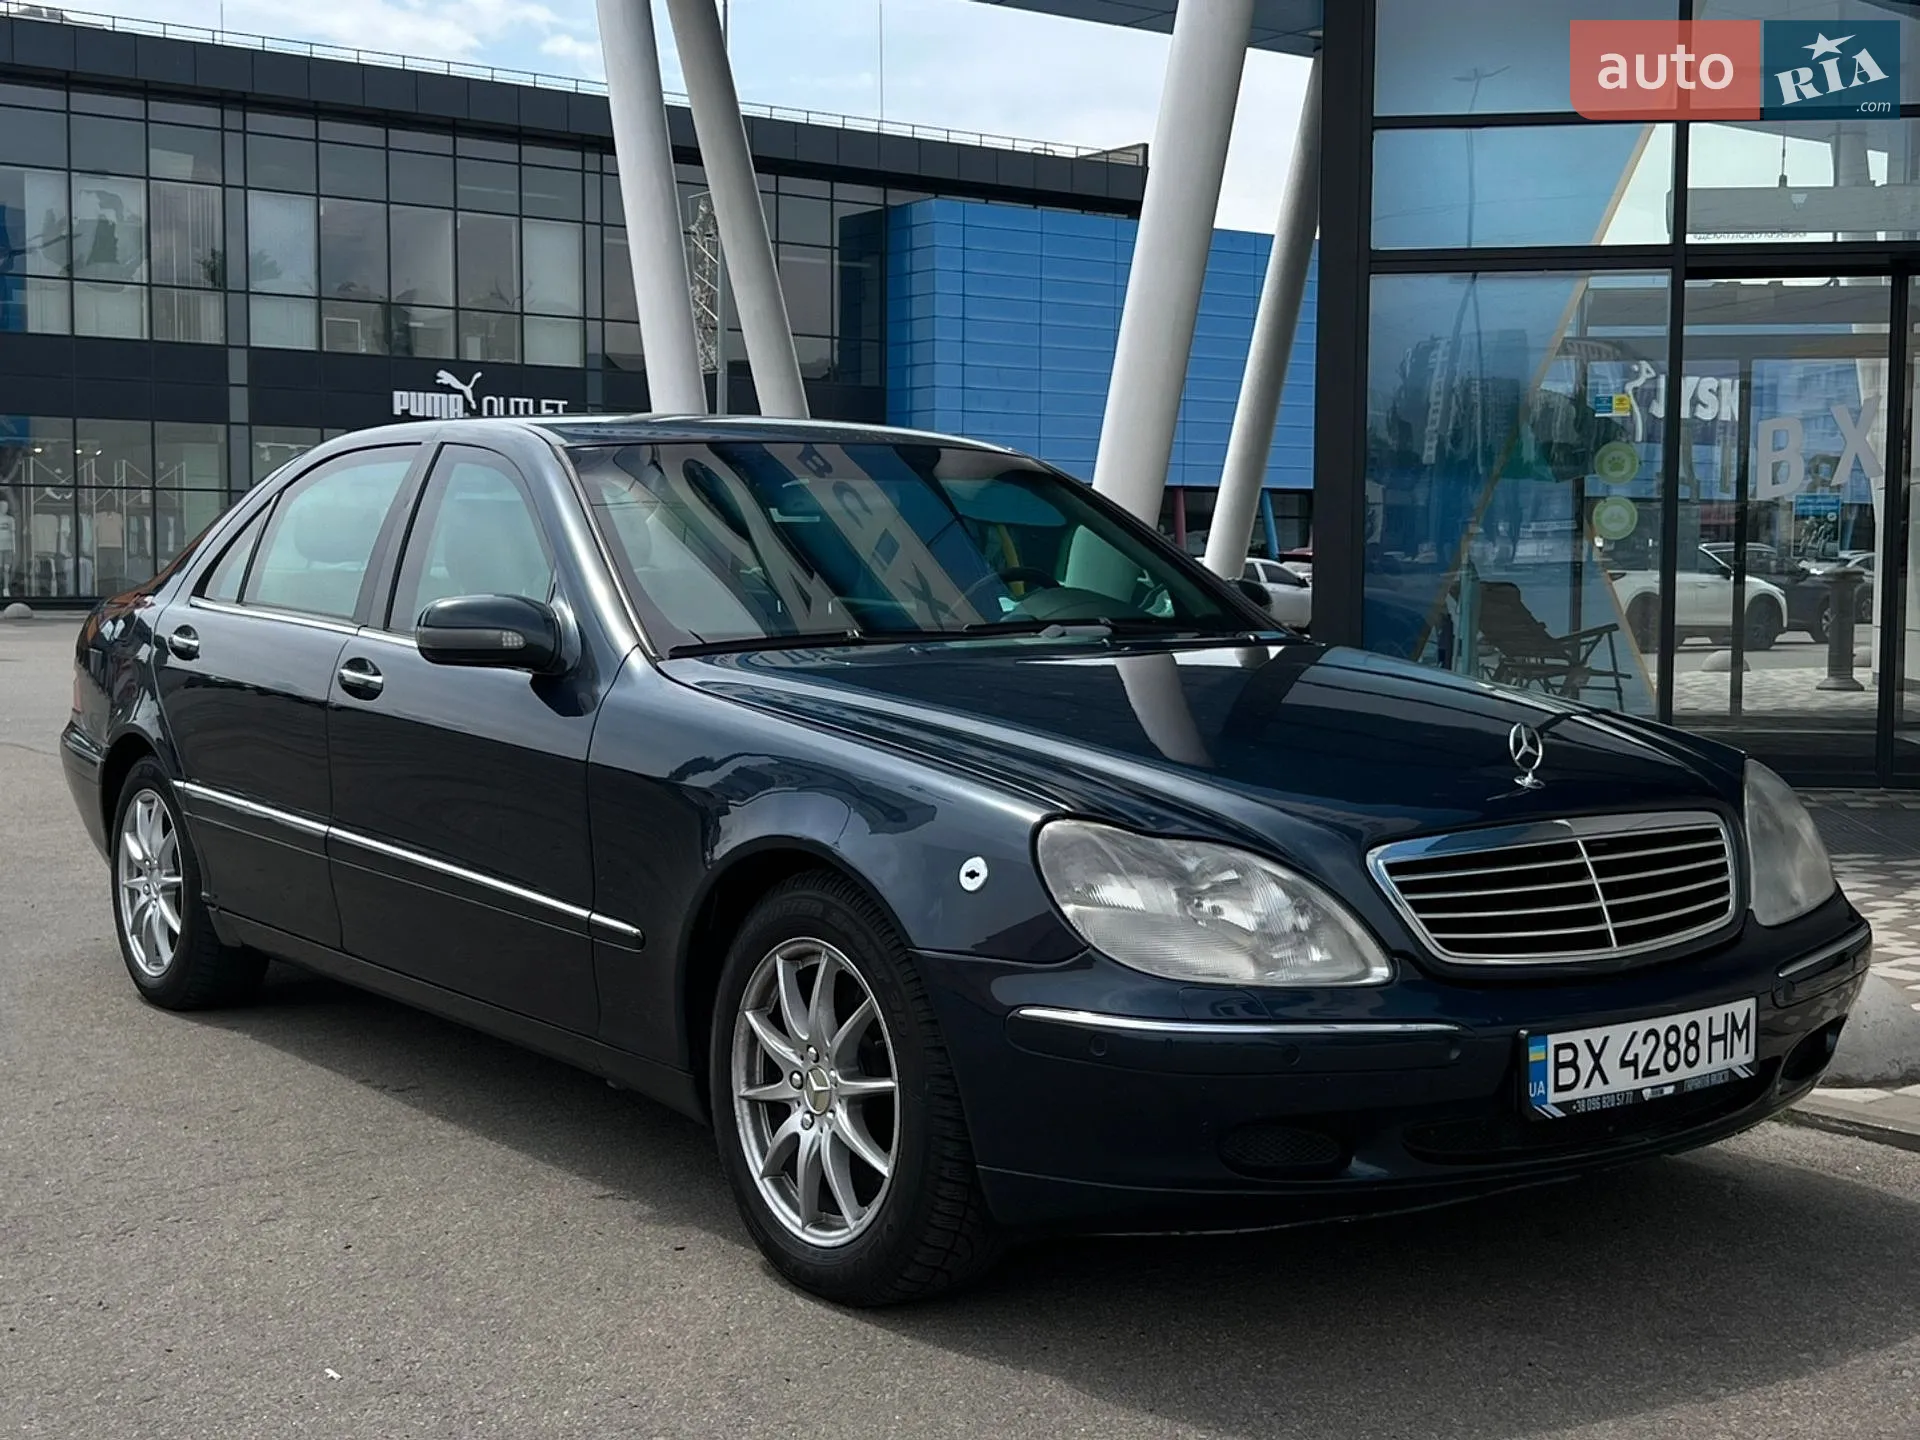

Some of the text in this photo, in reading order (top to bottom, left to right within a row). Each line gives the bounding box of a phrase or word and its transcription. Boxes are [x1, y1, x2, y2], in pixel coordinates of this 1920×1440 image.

[393, 390, 464, 419] PUMA
[1553, 1007, 1751, 1094] BX 4288 HM
[1528, 1082, 1546, 1098] UA
